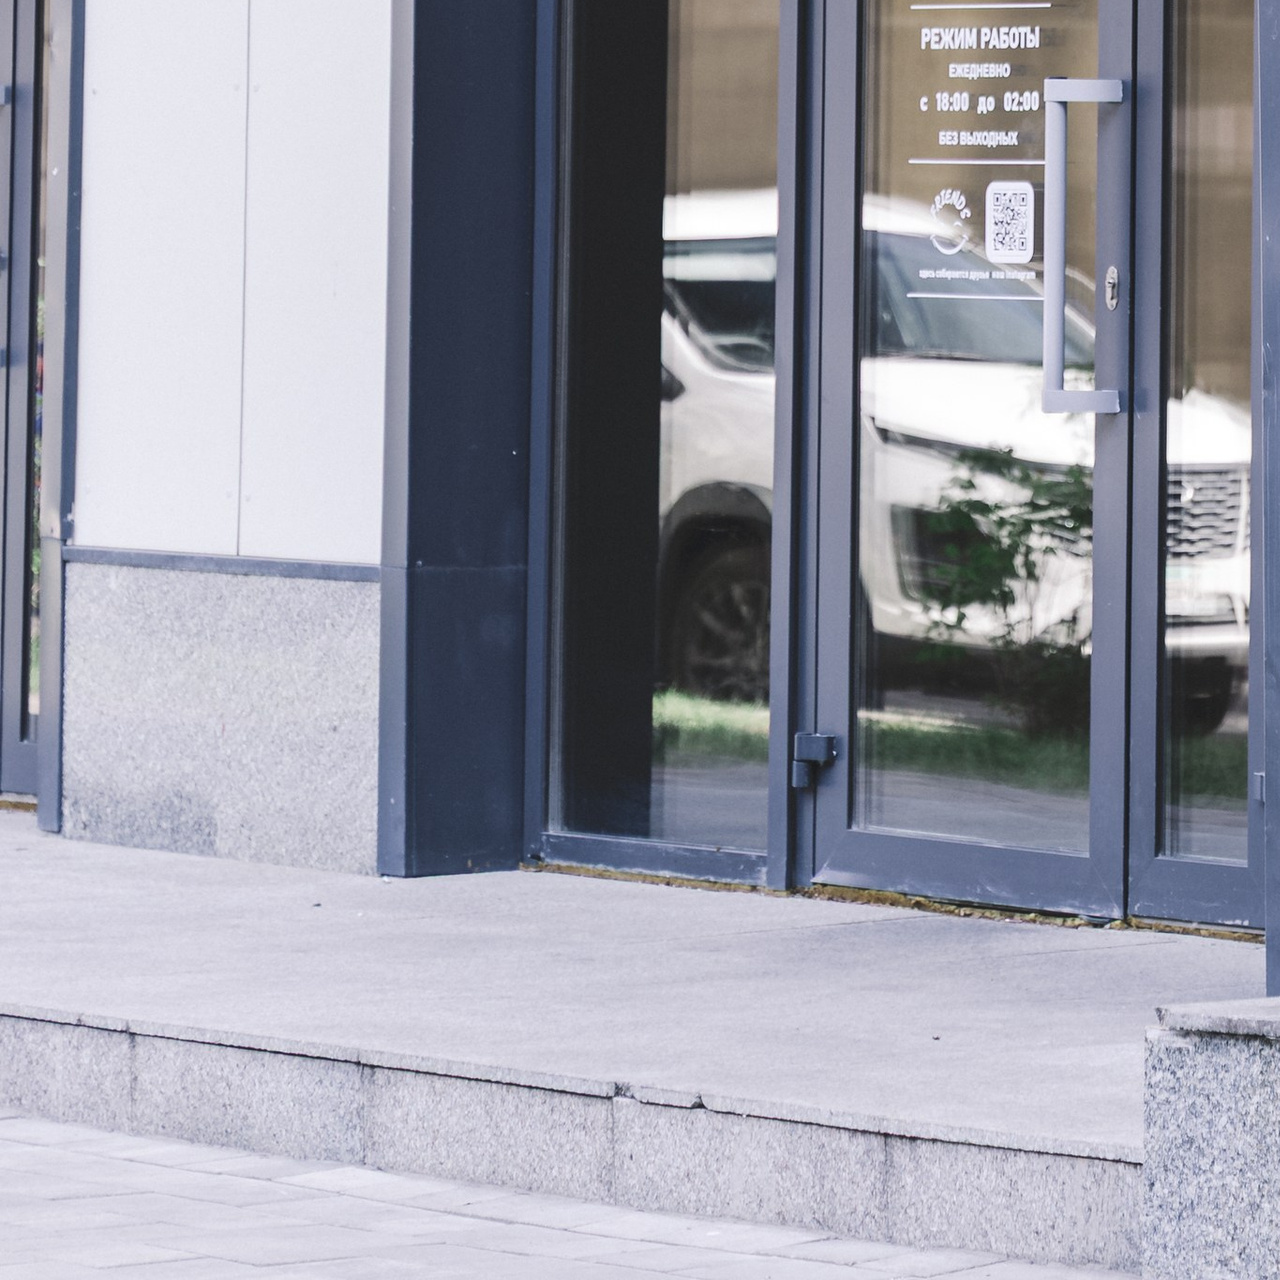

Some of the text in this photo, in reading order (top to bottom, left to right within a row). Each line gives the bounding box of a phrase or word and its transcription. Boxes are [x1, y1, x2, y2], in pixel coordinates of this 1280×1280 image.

[920, 25, 1040, 50] РЕЖИМ РАБОТЫ
[948, 63, 1011, 80] ЕЖЕДНЕВНО
[935, 91, 970, 112] 18:00
[977, 96, 996, 115] до
[1003, 90, 1040, 112] 02:00
[938, 130, 1019, 148] БЕЗ ВЫХОДНЫХ
